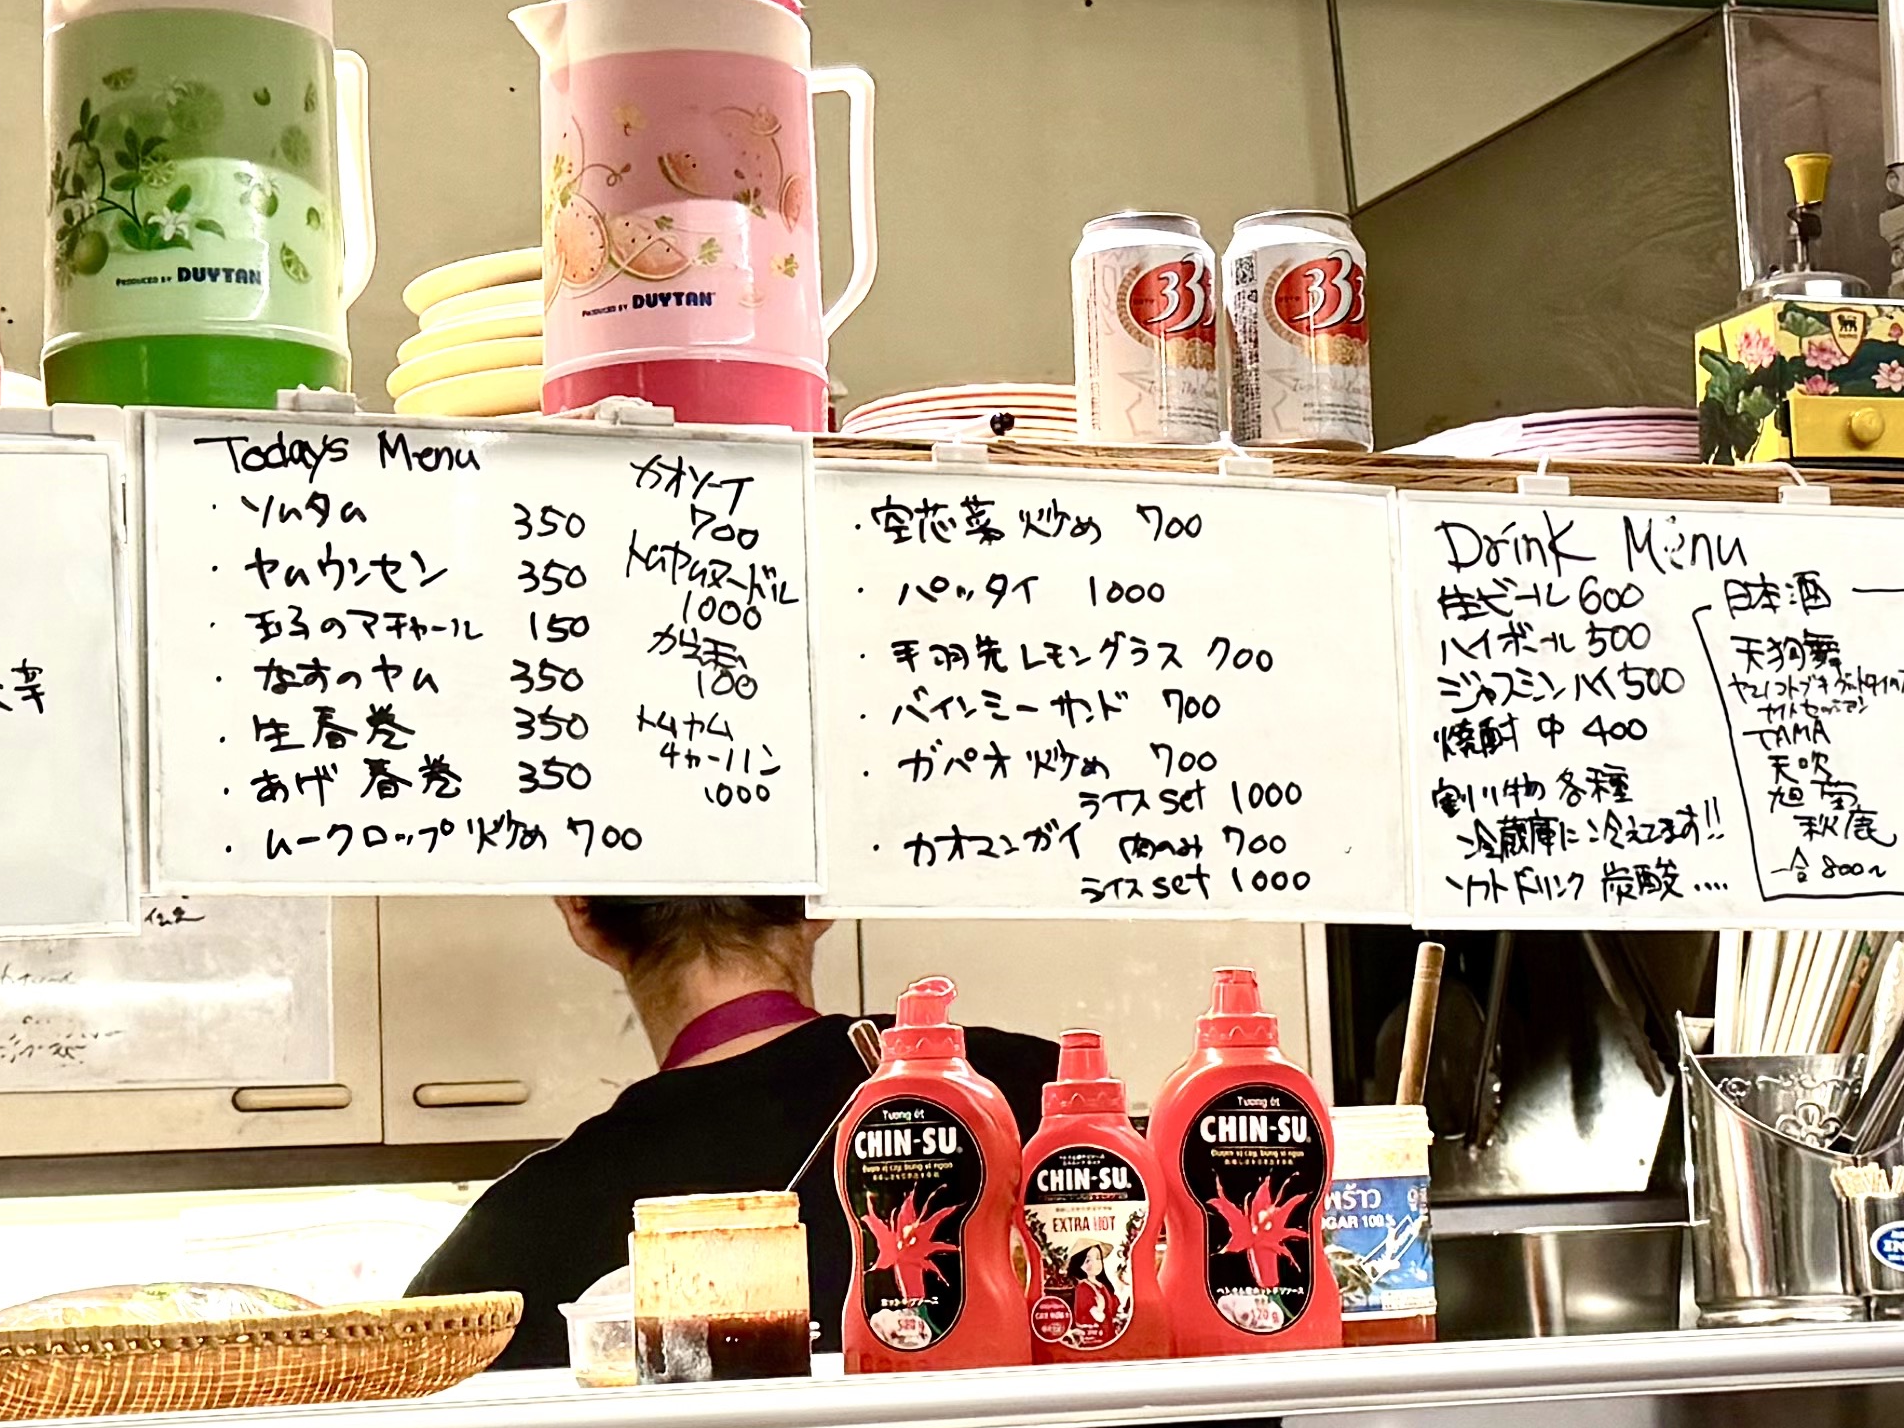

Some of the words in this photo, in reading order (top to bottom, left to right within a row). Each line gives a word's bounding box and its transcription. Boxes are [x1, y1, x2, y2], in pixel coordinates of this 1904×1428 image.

[177, 267, 261, 285] DUYTAN
[632, 292, 712, 309] DUYTAN
[378, 430, 480, 472] Menu
[514, 503, 585, 540] 350
[691, 504, 759, 550] 700
[1137, 504, 1201, 541] 700
[1435, 510, 1596, 577] Drink
[518, 559, 586, 595] 350
[1090, 576, 1164, 606] 1000
[1579, 575, 1644, 614] 600
[530, 612, 589, 642] 150
[683, 591, 761, 630] 1000
[1208, 637, 1272, 672] 700
[1586, 621, 1650, 658] 500
[510, 658, 583, 693] 350
[698, 670, 758, 700] 100
[1618, 662, 1684, 700] 500
[514, 705, 588, 740] 350
[1162, 689, 1220, 724] 700
[1582, 715, 1647, 746] 400
[519, 756, 591, 793] 350
[1150, 743, 1217, 777] 700
[705, 783, 770, 807] 1000
[1159, 779, 1205, 815] set
[1232, 781, 1302, 814] 1000
[567, 817, 642, 857] 700
[1222, 826, 1286, 855] 700
[1153, 863, 1210, 899] set
[1232, 867, 1310, 892] 1000
[855, 1126, 957, 1159] CHIN-SU
[1200, 1115, 1307, 1143] CHIN-SU
[1037, 1167, 1128, 1192] CHIN-SU
[1053, 1217, 1090, 1233] EXTRA
[1093, 1216, 1116, 1231] HOT
